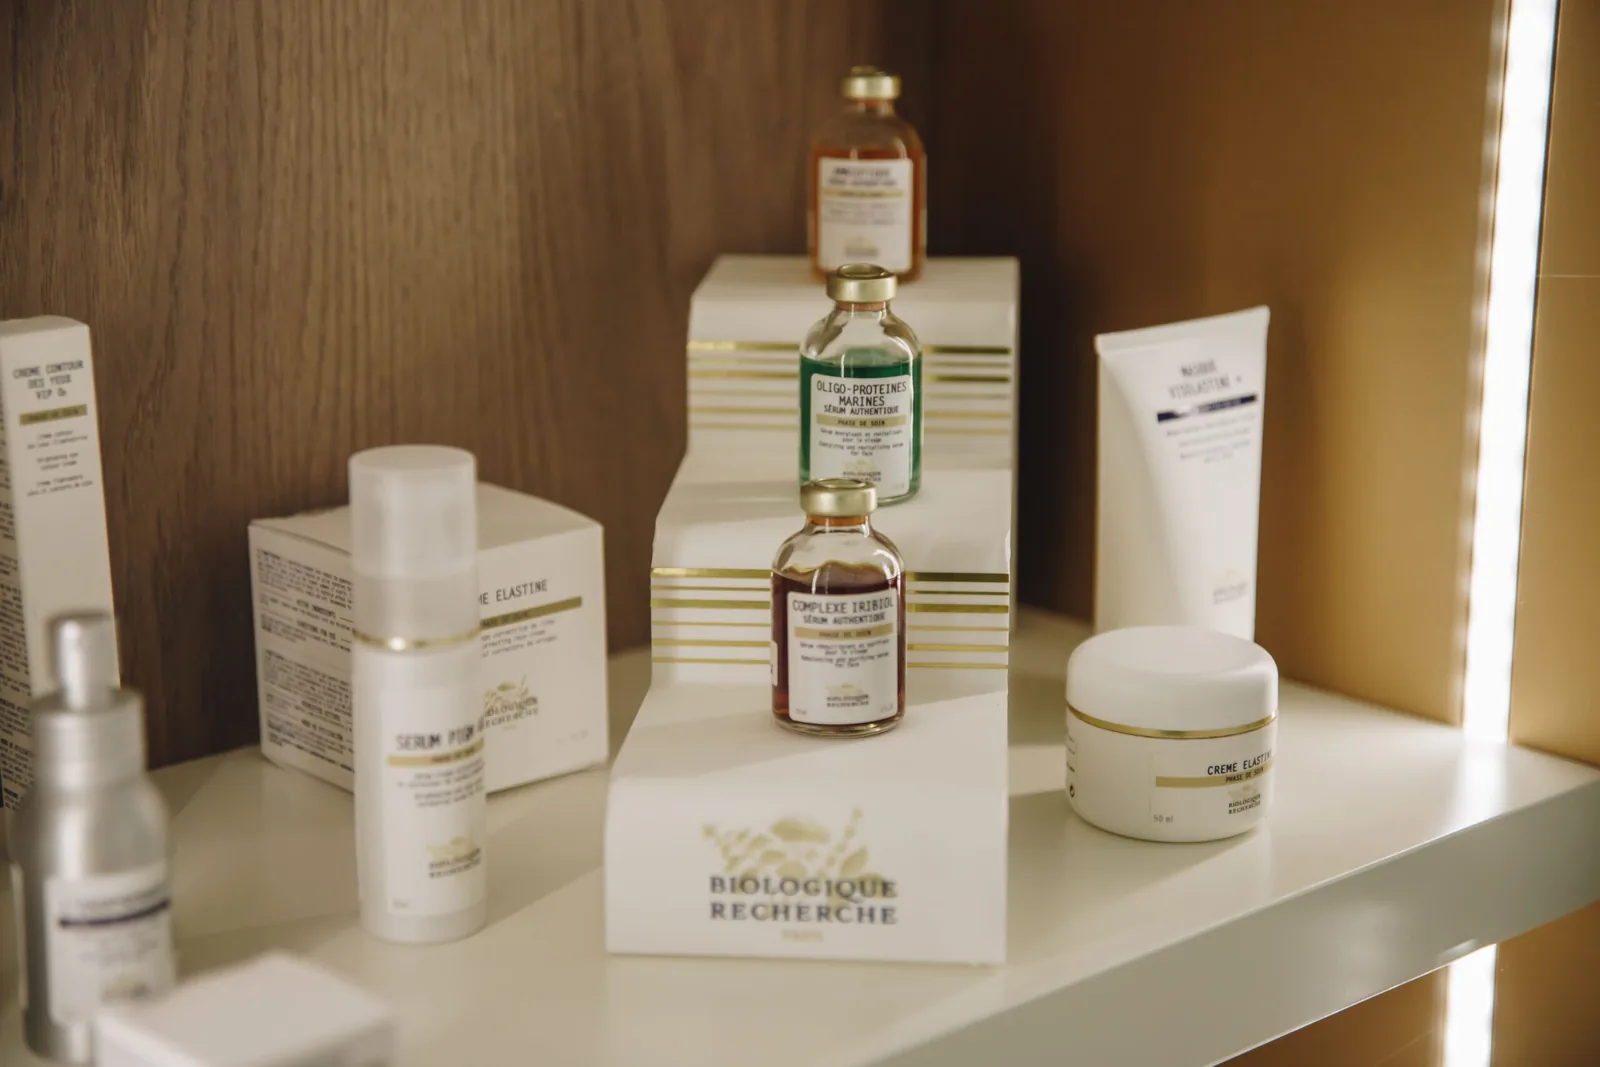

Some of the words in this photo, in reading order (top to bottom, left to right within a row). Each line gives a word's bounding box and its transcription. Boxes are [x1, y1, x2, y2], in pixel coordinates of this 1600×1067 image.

[45, 360, 84, 374] CONTOUR
[817, 380, 907, 395] OLIGO-PROTEINES
[839, 396, 885, 407] MARINES
[824, 404, 846, 414] SÉRUM
[850, 405, 899, 415] AUTHENTIQUE
[496, 579, 548, 602] ELASTINE
[792, 600, 848, 614] COMPLEXE
[852, 596, 894, 613] IRIBIOL
[803, 614, 828, 625] SÉRUM
[833, 612, 886, 625] AUTHENTIQUE
[395, 734, 441, 751] SERUM
[1207, 762, 1238, 775] CREME
[1225, 773, 1243, 783] PHASE
[709, 875, 899, 904] BIOLOGIQUE
[709, 902, 899, 925] RECHERCHE
